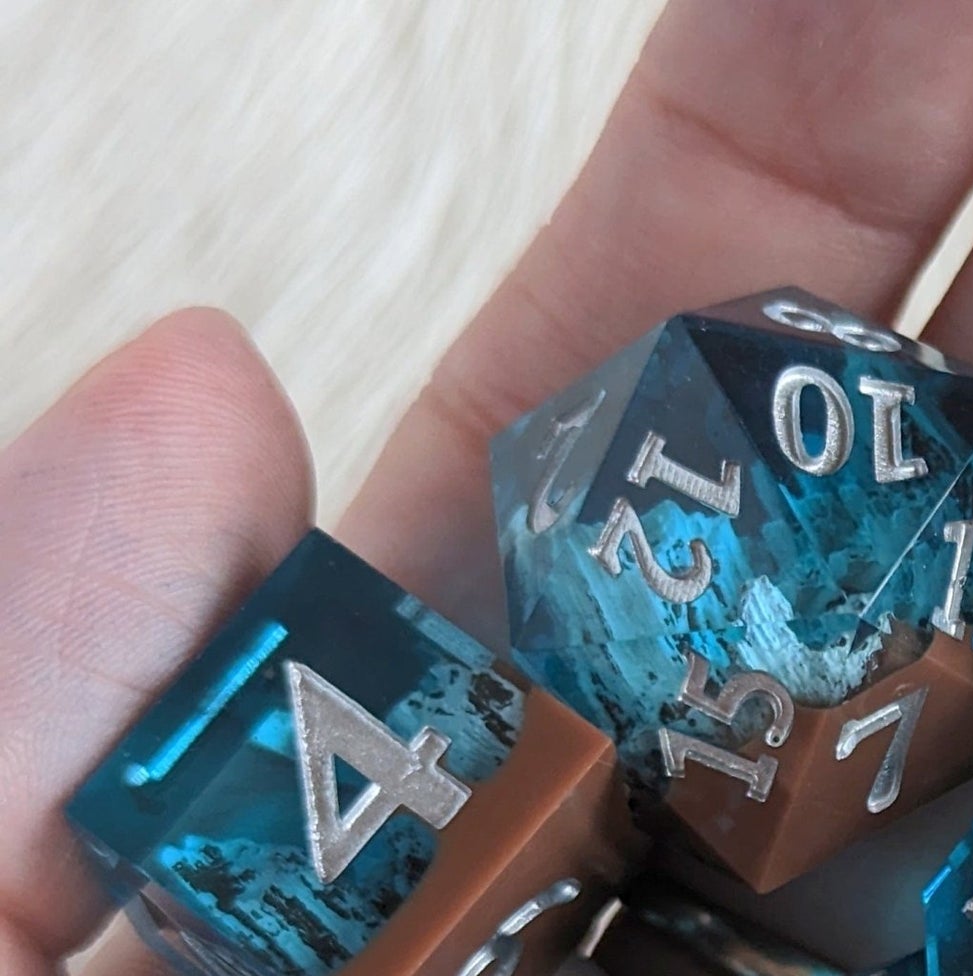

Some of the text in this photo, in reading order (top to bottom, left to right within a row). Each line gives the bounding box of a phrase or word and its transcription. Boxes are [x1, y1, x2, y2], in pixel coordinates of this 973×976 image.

[761, 300, 902, 353] 8
[771, 364, 930, 484] 10
[587, 430, 741, 604] 12
[284, 659, 473, 885] 4
[658, 640, 796, 803] 15
[835, 685, 930, 815] 7
